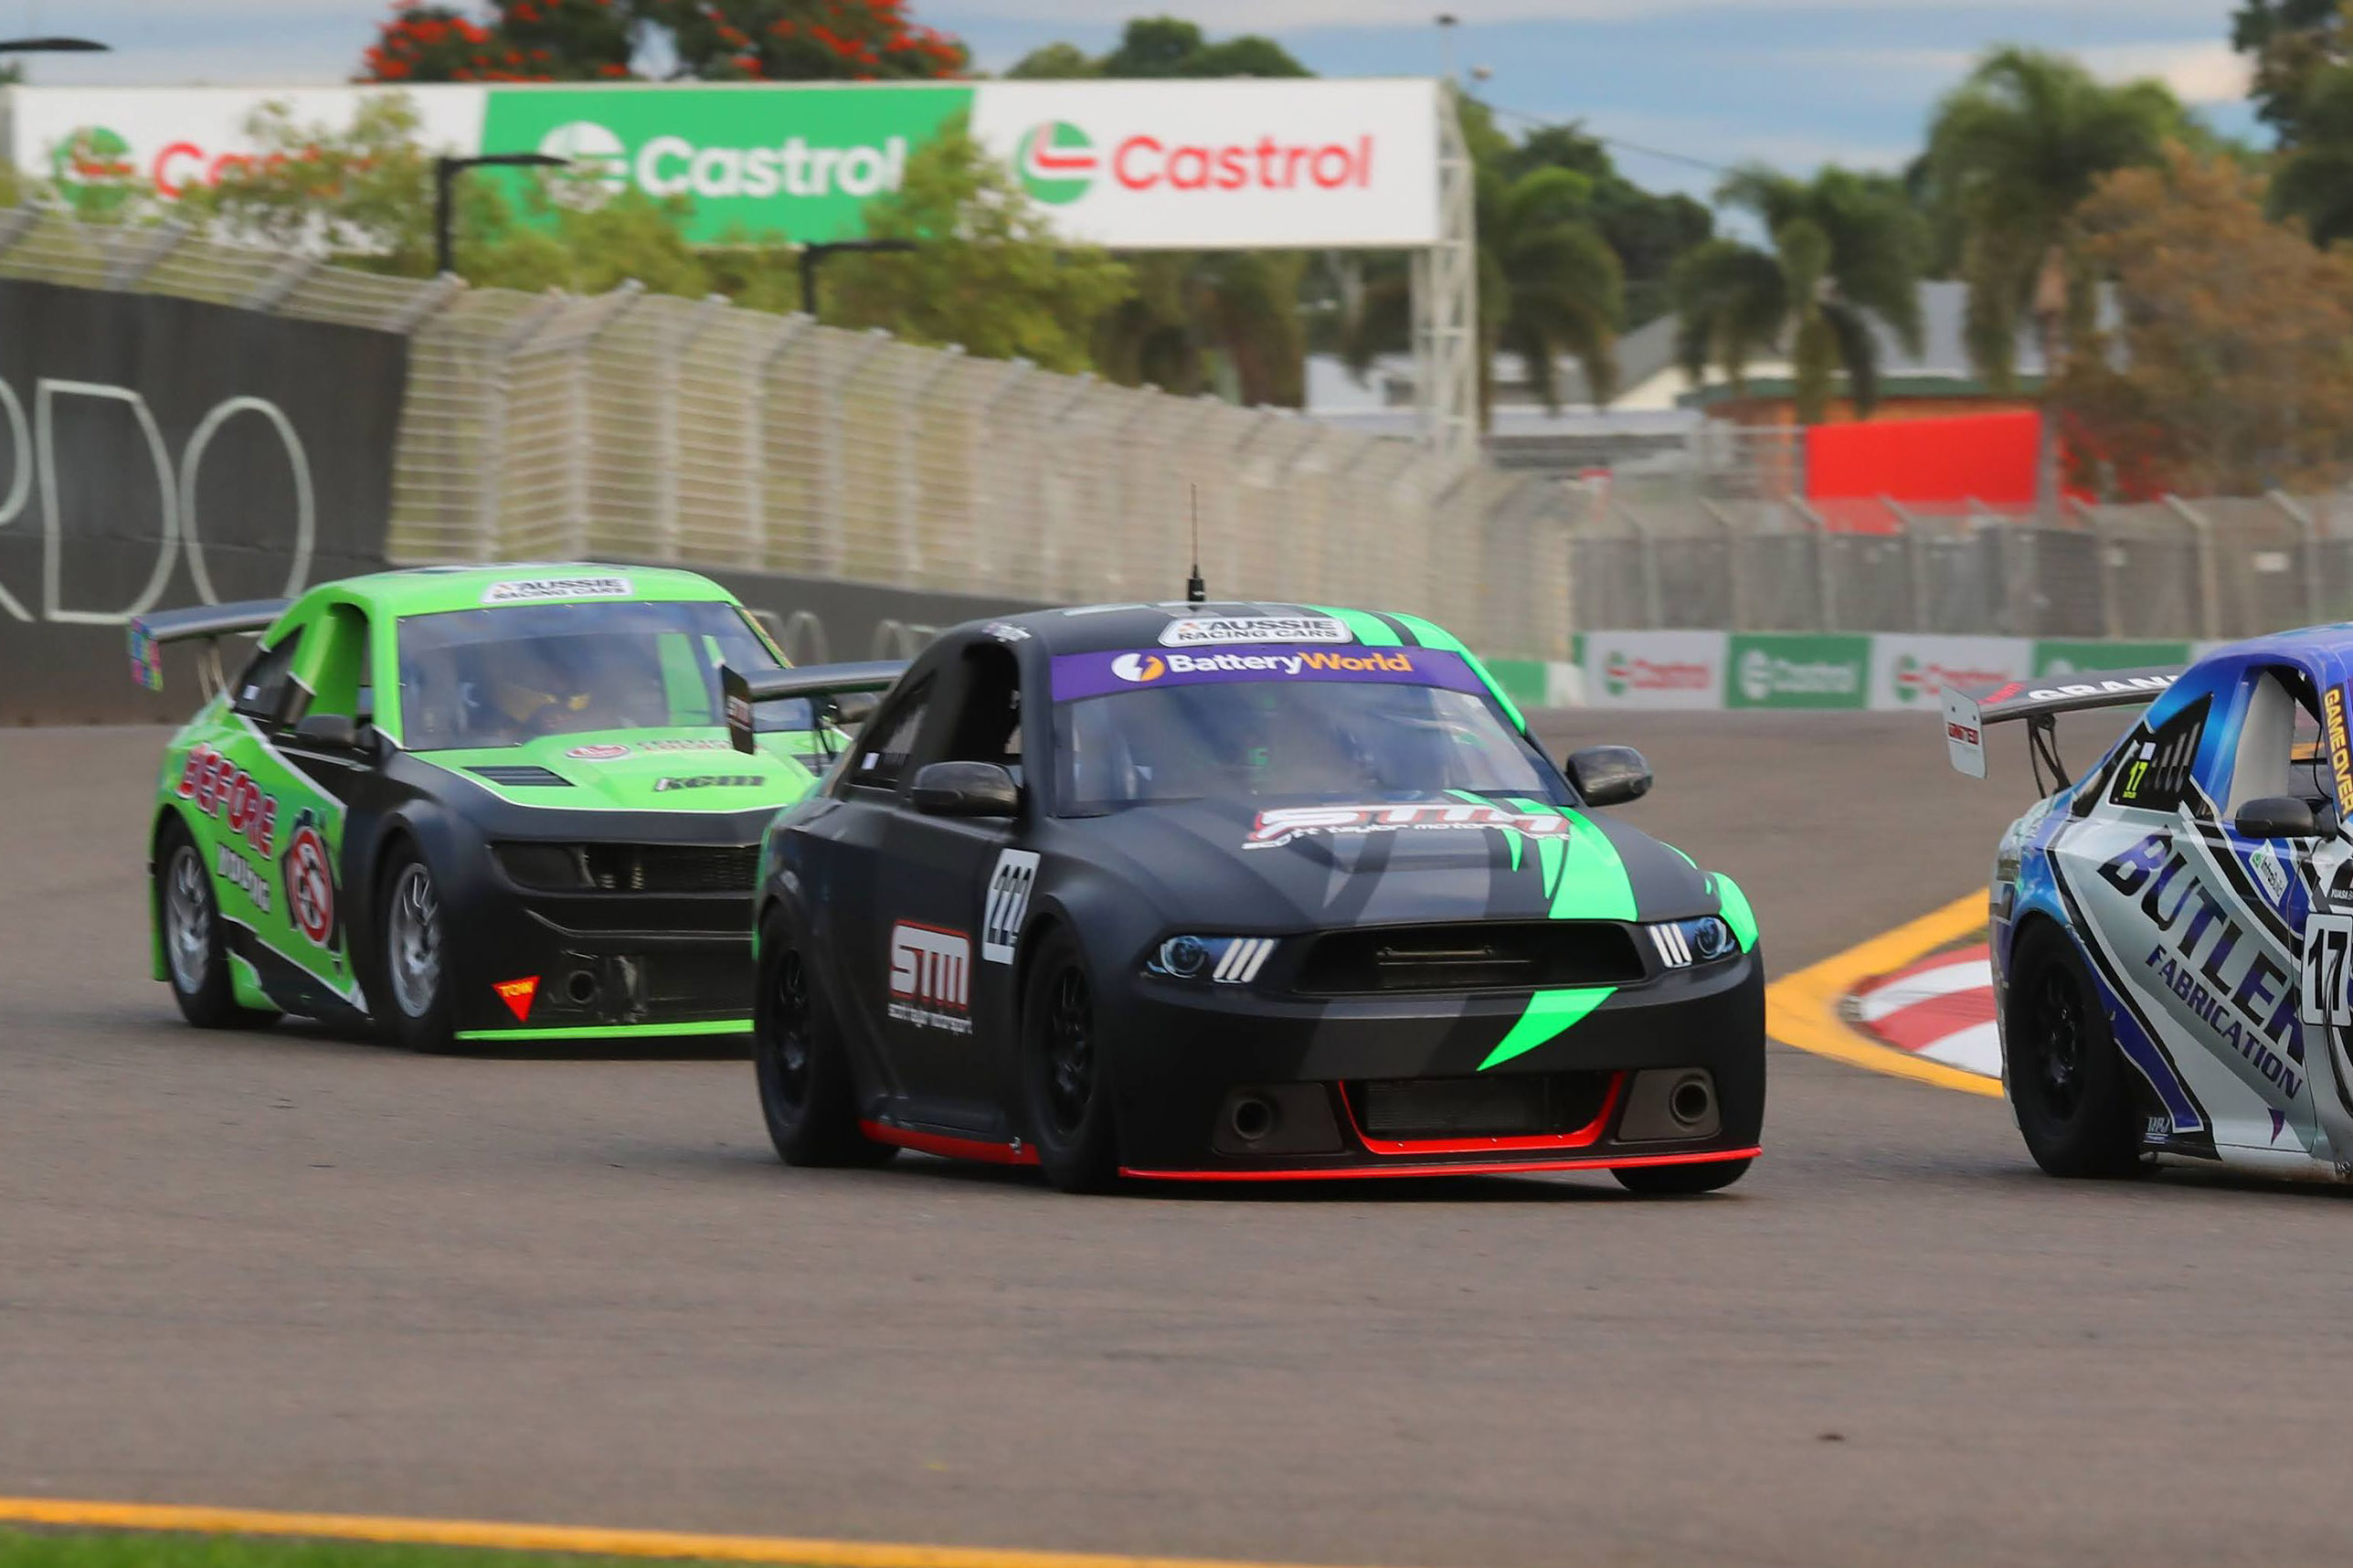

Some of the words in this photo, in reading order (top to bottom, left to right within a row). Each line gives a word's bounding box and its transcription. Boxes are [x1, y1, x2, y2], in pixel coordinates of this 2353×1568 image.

[636, 135, 907, 196] Castrol
[1113, 135, 1373, 191] Castrol
[1178, 630, 1267, 641] RACING
[1276, 629, 1339, 638] CARS
[1209, 620, 1336, 630] AUSSIE
[176, 741, 279, 860] BEFORE
[2125, 760, 2148, 791] 17
[1252, 804, 1569, 841] STM
[498, 981, 534, 997] TOW
[890, 920, 970, 1009] STM
[2308, 928, 2348, 1012] 17
[2145, 944, 2304, 1100] FABRICATION
